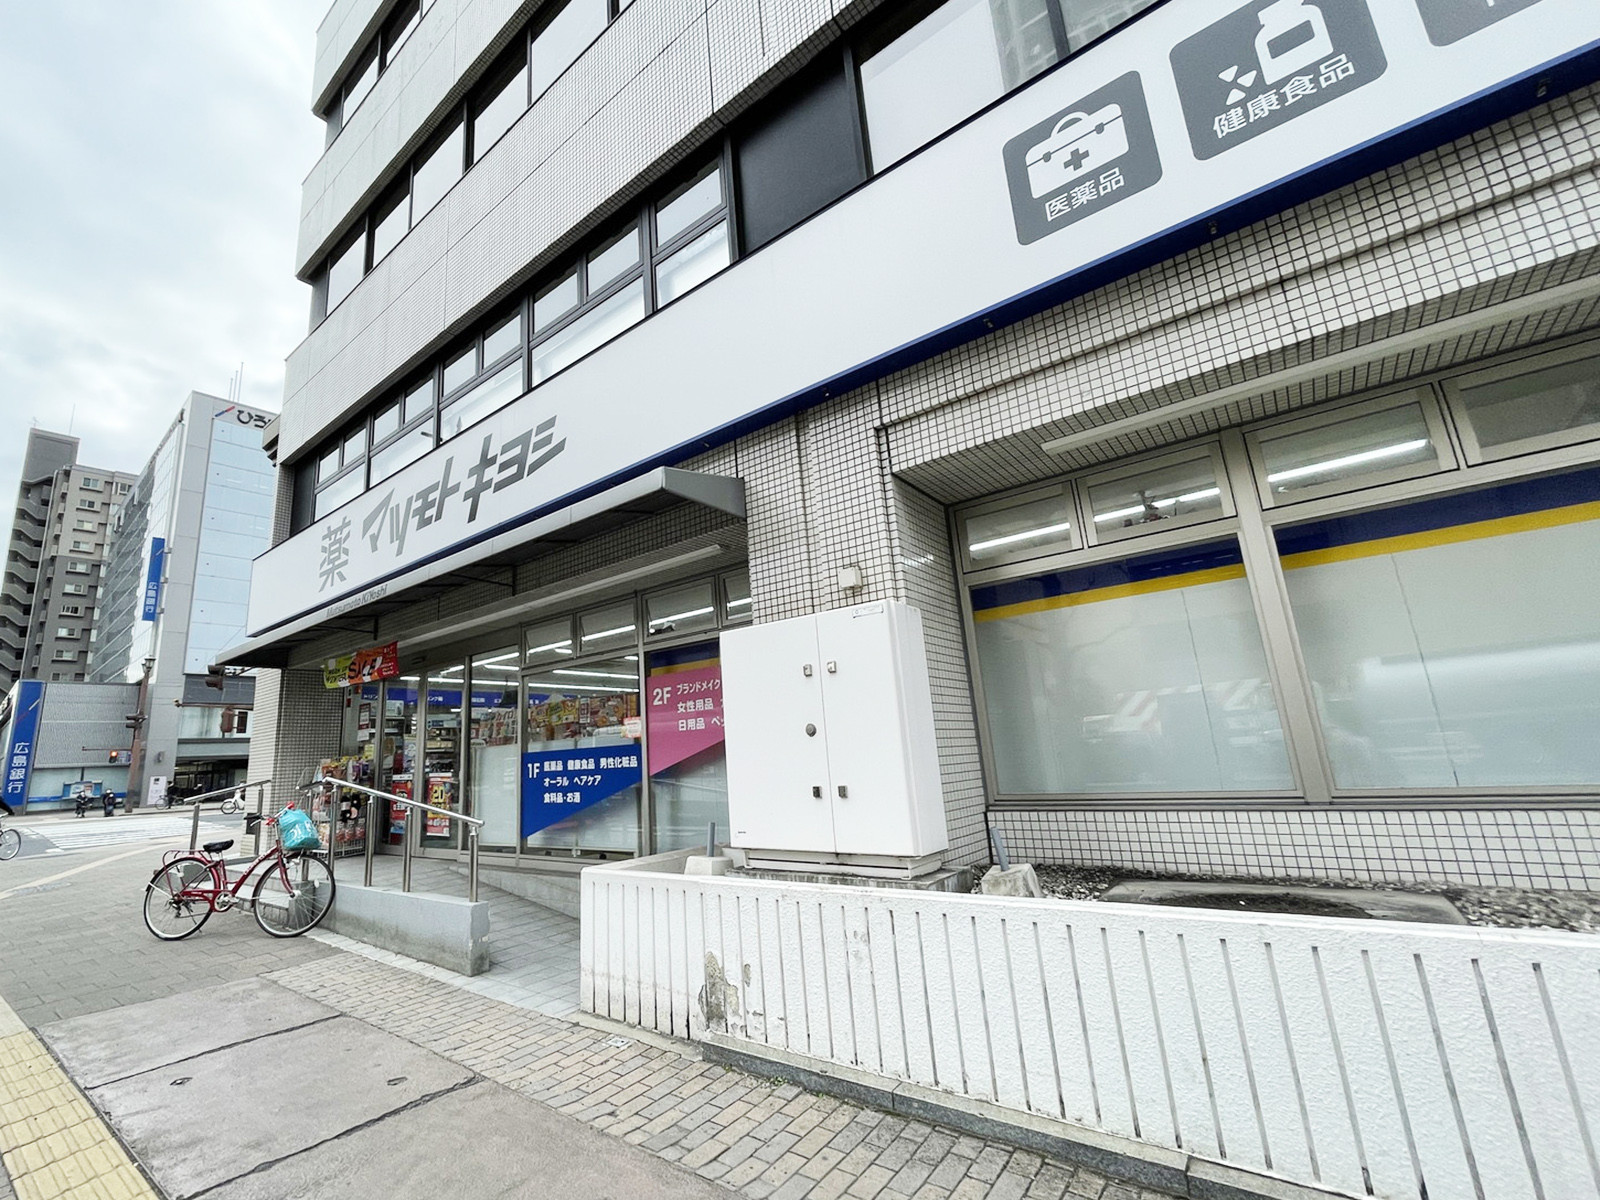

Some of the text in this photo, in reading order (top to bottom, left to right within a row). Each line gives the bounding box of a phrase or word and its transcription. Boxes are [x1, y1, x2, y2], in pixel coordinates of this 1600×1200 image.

[1212, 52, 1356, 139] 健康食品
[1044, 165, 1126, 223] 医薬品
[318, 414, 567, 593] 薬 マツモトキヨシ
[653, 678, 721, 706] 2F ブランドメイク
[677, 697, 714, 713] 女性用品
[678, 717, 706, 731] 日用品
[7, 741, 31, 794] 広島銀行
[527, 763, 540, 779] 1F
[599, 755, 638, 769] 男性化粧品
[543, 775, 602, 787] オーラル ヘアケア
